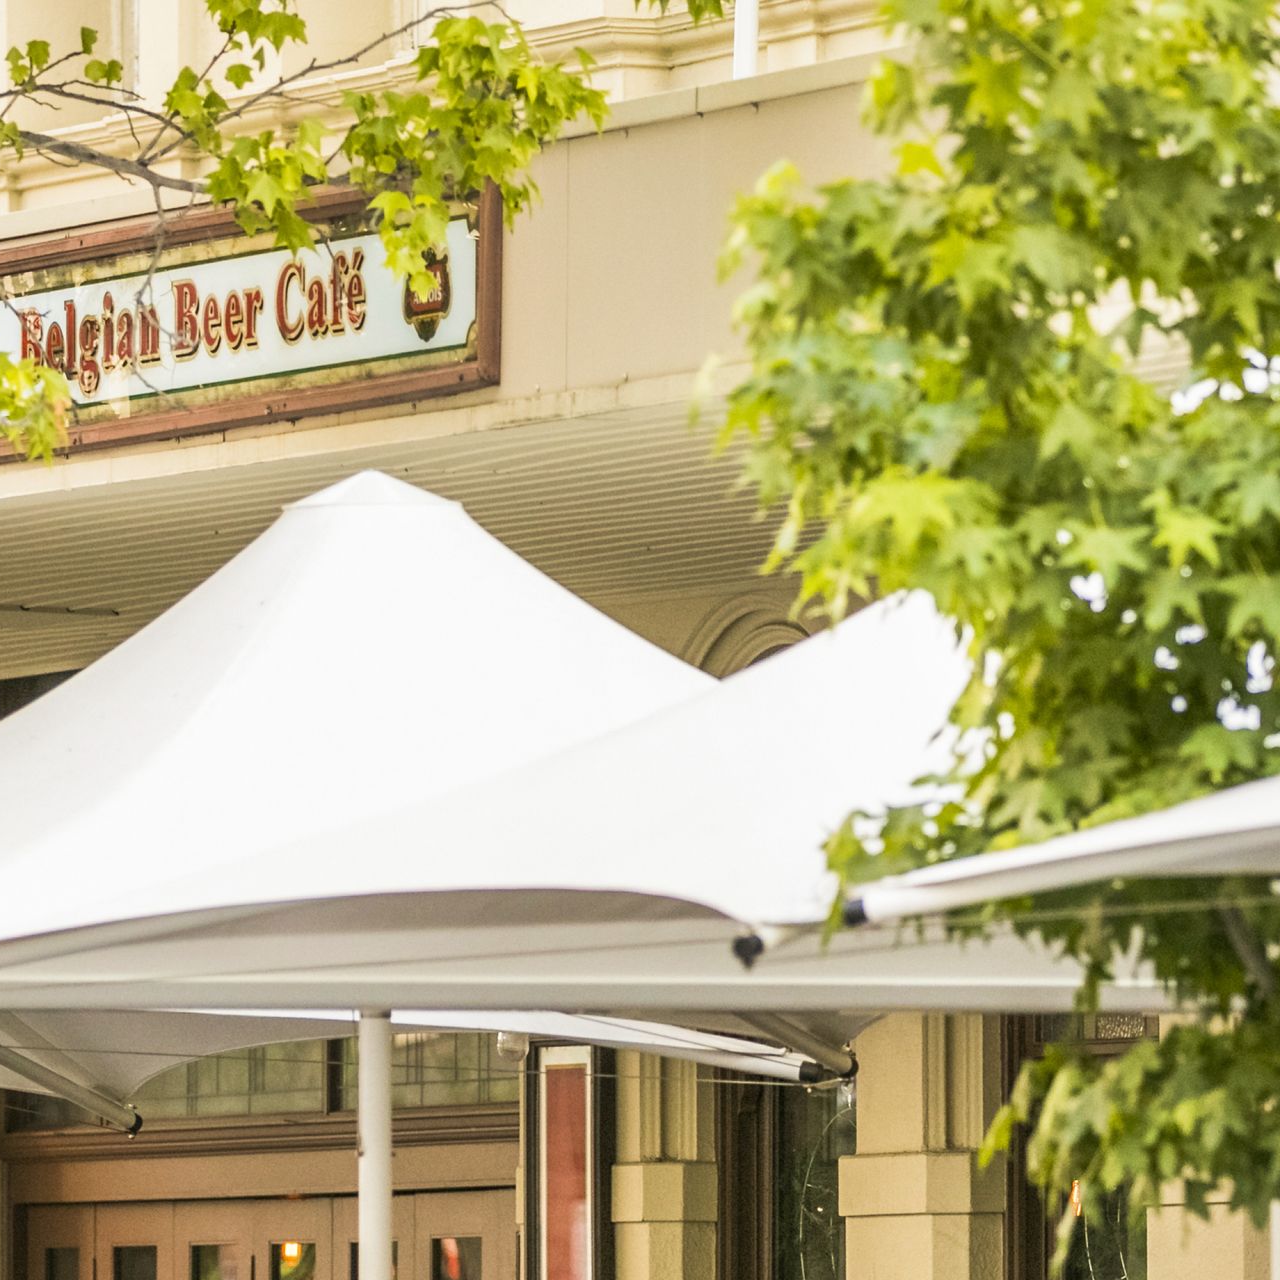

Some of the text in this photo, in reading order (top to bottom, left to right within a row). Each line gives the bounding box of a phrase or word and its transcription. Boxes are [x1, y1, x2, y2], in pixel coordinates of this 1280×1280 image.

[19, 246, 367, 398] Belgian Beer Café
